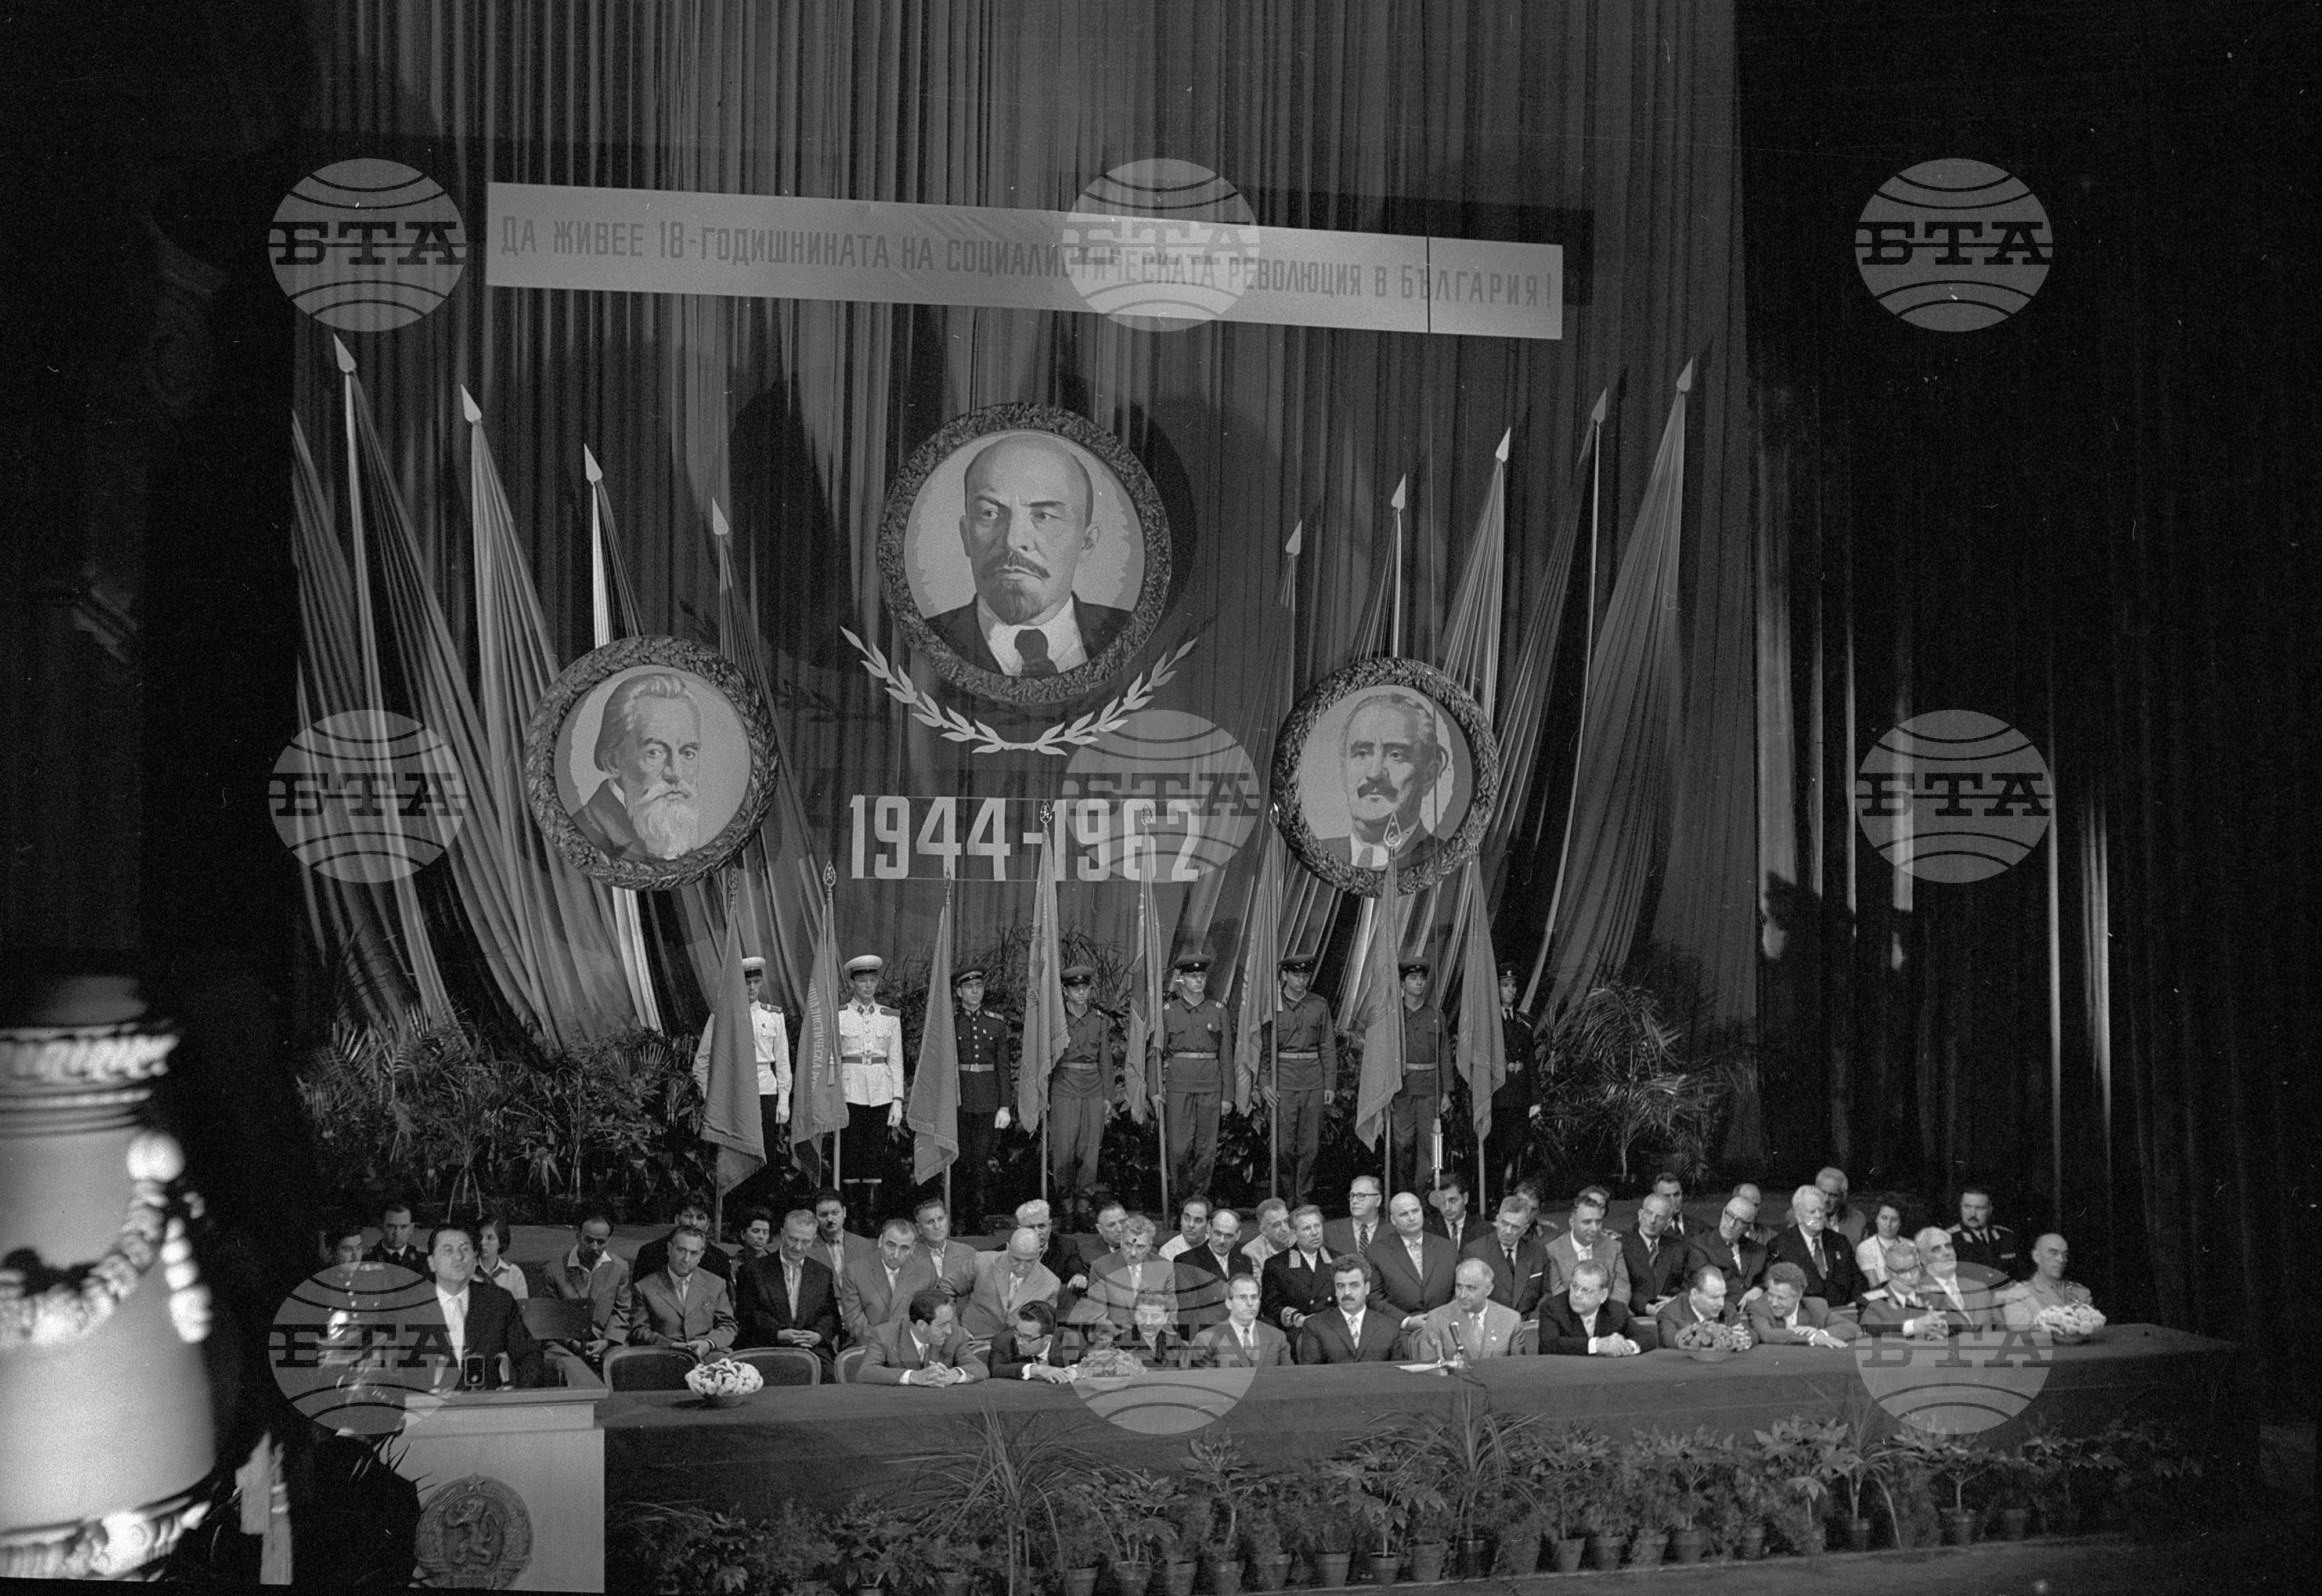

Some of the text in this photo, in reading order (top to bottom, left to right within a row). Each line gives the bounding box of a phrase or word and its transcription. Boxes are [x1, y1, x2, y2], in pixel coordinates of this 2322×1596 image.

[501, 215, 536, 257] ДА
[553, 220, 644, 257] ЖИВЕЕ
[659, 220, 889, 269] 18-ГОДИШНИНАТА
[902, 236, 934, 271] НА
[1228, 257, 1361, 298] РЕВОЛЮЦИЯ
[1375, 265, 1387, 298] В
[1401, 265, 1552, 307] БЪЛГАРИЯ!
